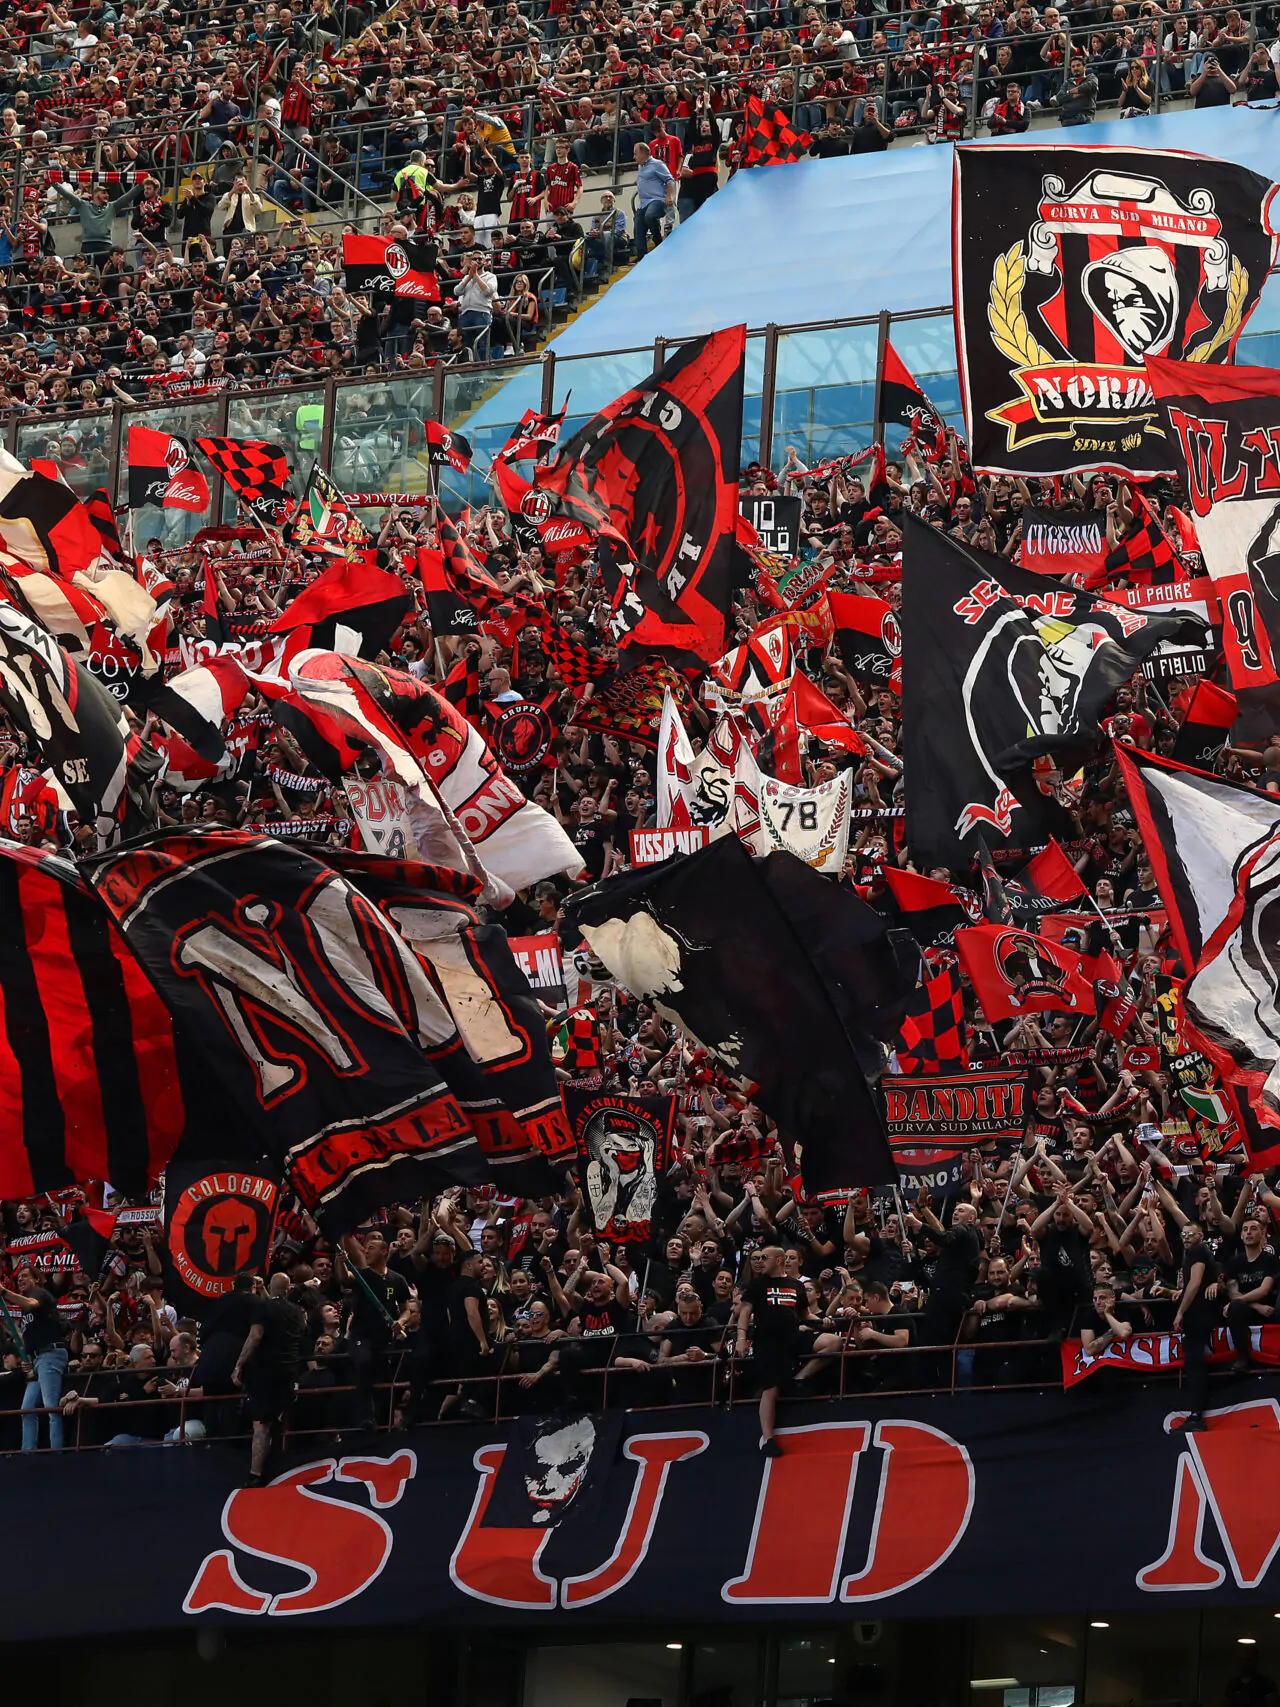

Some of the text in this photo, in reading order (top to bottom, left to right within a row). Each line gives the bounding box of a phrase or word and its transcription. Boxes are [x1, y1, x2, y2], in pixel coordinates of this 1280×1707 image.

[1051, 205, 1209, 232] CURVA SUD MILANO
[1026, 523, 1102, 556] CUGGIONO
[1127, 582, 1192, 606] DI PADRE
[1142, 655, 1206, 681] IN FIGLIO
[633, 829, 702, 863] CASSANO
[885, 1083, 1025, 1123] BANDITI
[888, 1117, 1023, 1133] CURVA SUD MILANO
[187, 1174, 273, 1203] COLOGNO
[34, 1254, 53, 1266] AC
[183, 1418, 977, 1617] SUD
